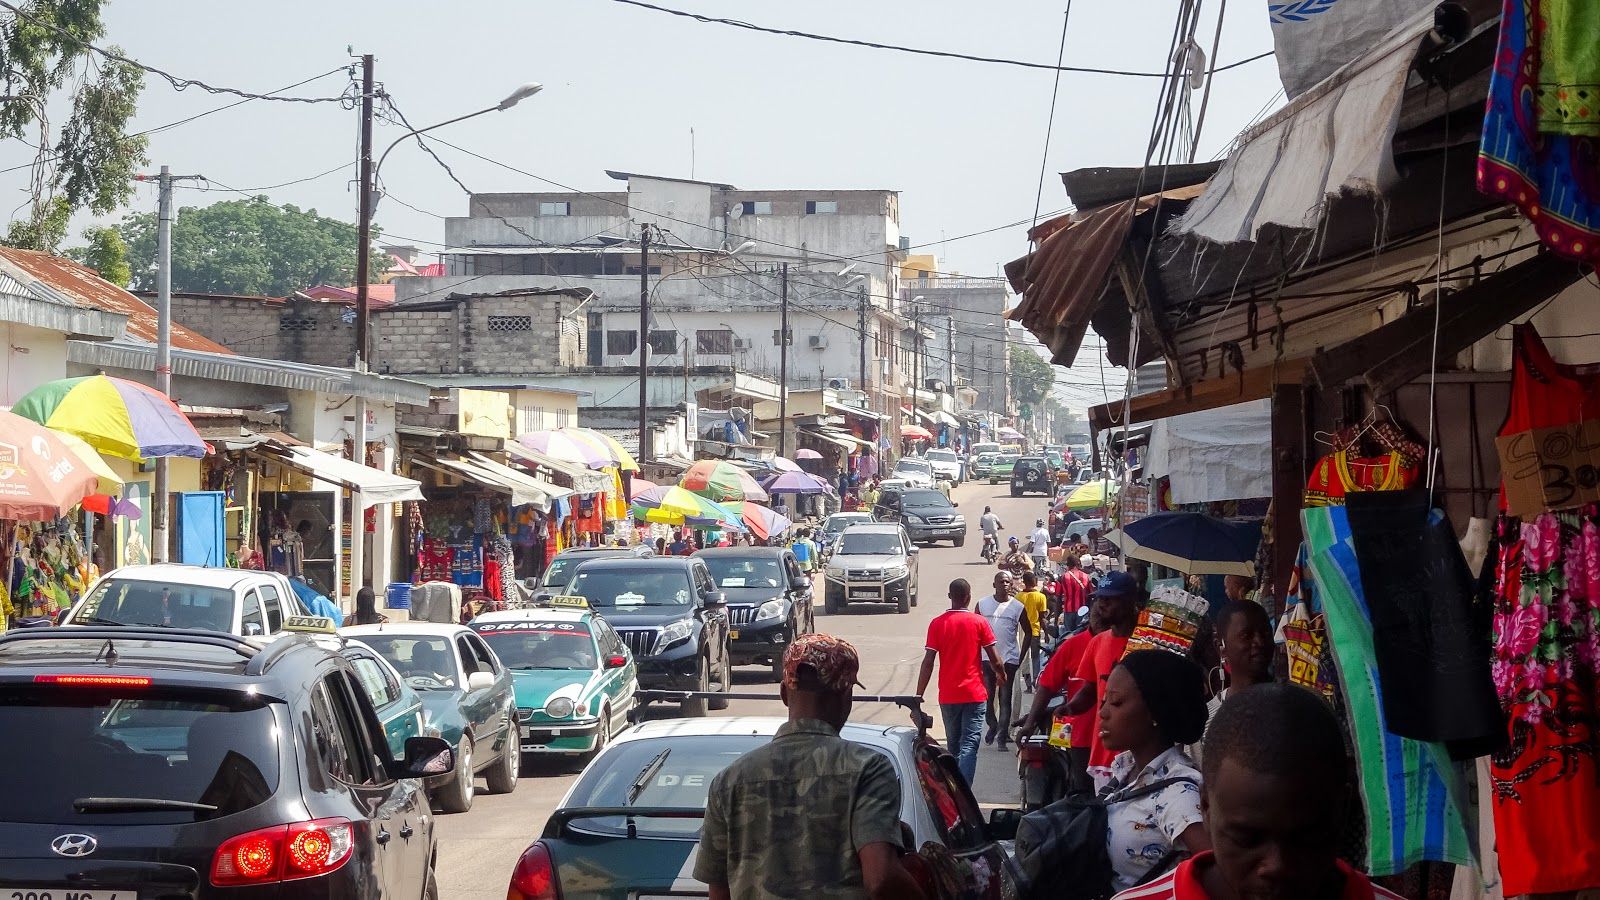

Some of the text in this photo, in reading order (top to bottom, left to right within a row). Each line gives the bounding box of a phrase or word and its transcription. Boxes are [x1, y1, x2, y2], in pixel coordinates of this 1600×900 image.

[49, 456, 75, 483] airtel
[556, 596, 582, 605] TAXI
[290, 617, 328, 628] TAXI
[496, 622, 556, 631] RAV4
[657, 774, 705, 787] DE
